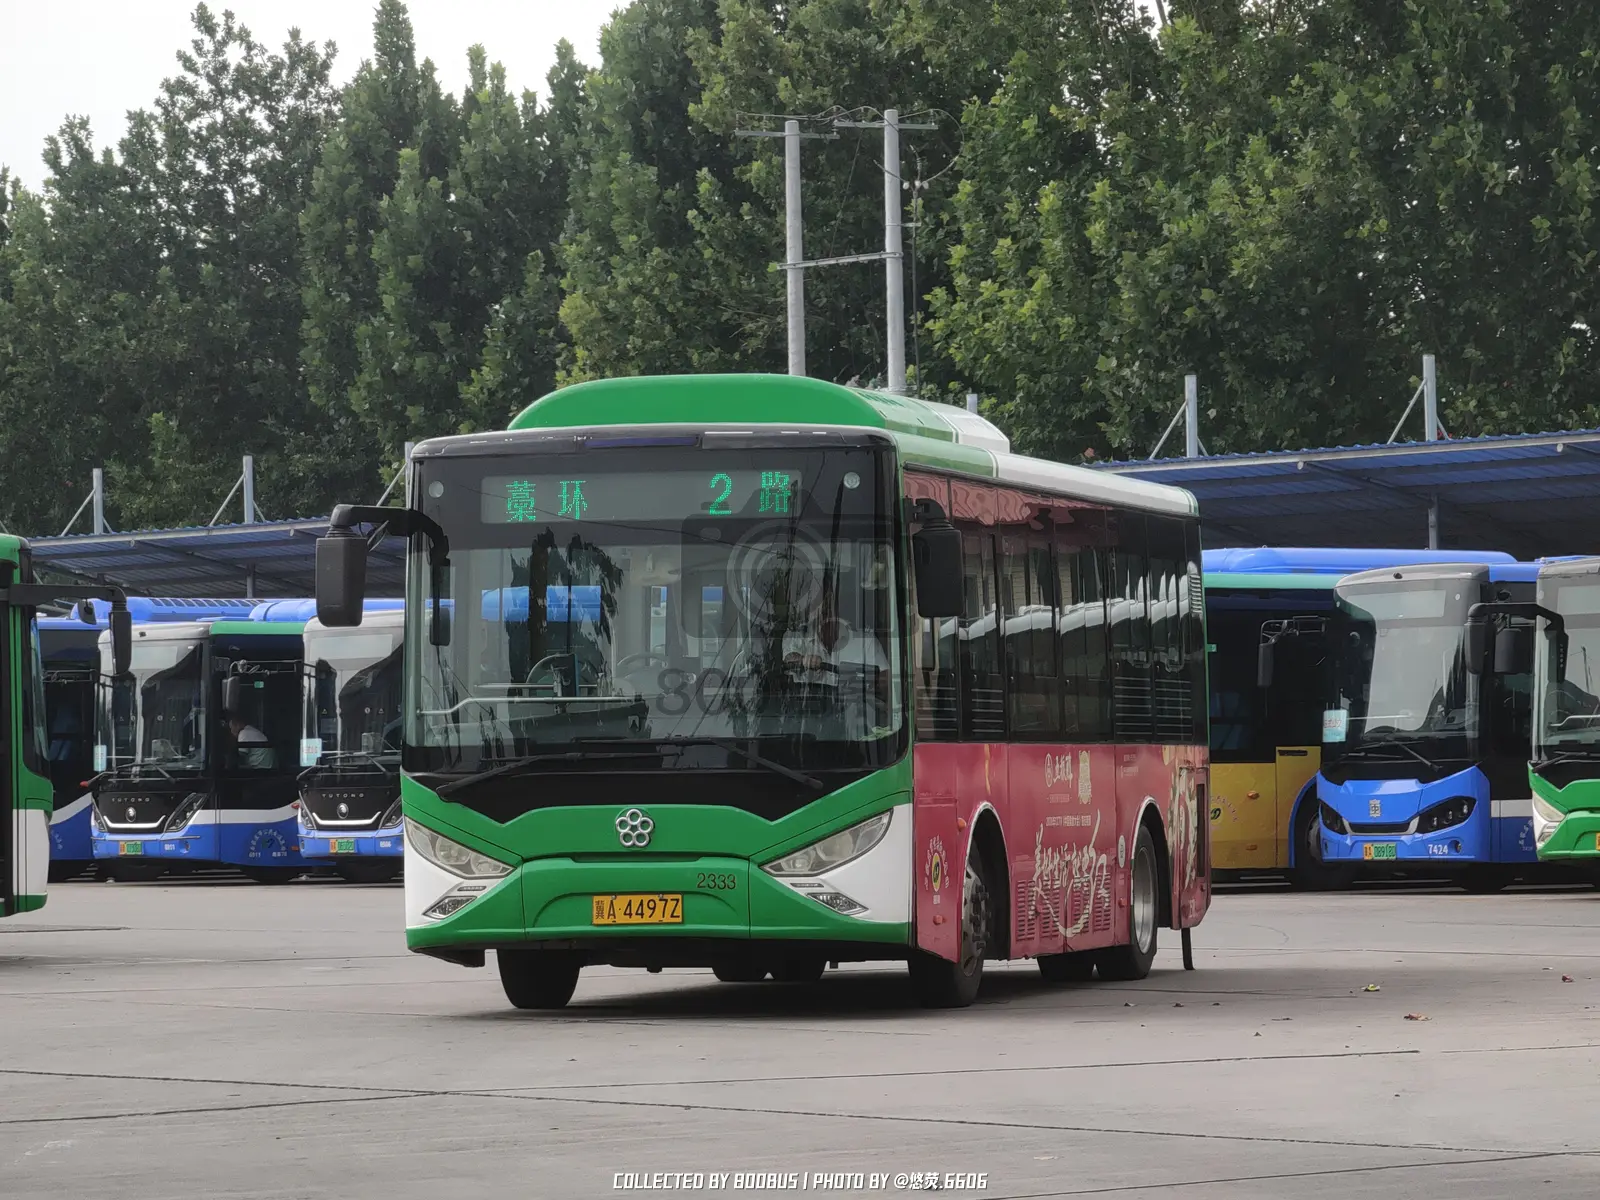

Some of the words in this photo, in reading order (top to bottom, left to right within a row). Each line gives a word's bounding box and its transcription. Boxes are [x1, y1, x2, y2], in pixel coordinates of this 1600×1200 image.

[505, 480, 588, 521] 藁环
[1428, 844, 1448, 854] 7424
[697, 872, 737, 890] 2333
